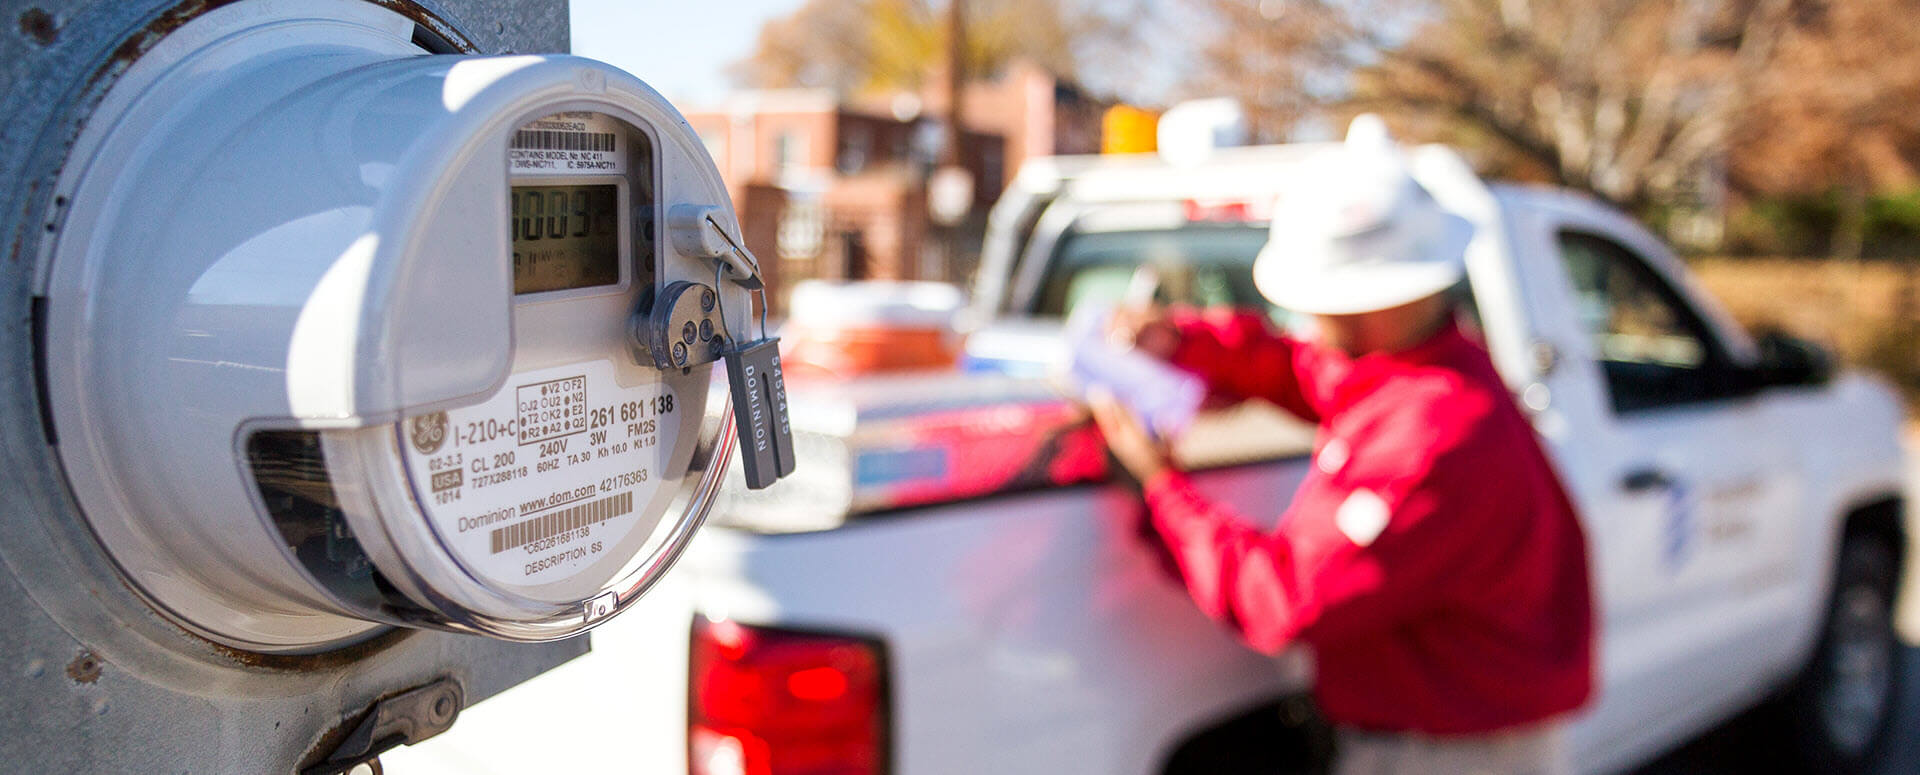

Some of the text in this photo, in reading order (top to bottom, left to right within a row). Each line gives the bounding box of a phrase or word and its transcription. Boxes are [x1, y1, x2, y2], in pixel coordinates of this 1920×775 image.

[546, 151, 568, 160] MODEL
[581, 152, 591, 161] NIC
[592, 152, 603, 160] 411
[548, 379, 582, 394] V2 F2
[528, 392, 583, 411] J2 U2 N2
[528, 405, 583, 424] T2 K2 E2
[590, 394, 674, 429] 261 681 138
[745, 365, 767, 452] DOMINION
[528, 417, 584, 438] R2 A2 Q2
[471, 419, 656, 473] CL 200 240V 3W FM2S
[537, 459, 560, 473] 60HZ
[567, 454, 579, 466] TA
[581, 451, 591, 463] 30
[598, 447, 609, 458] Kh
[612, 442, 627, 454] 10.0
[634, 439, 643, 449] Kt
[645, 436, 656, 447] 1.0
[432, 469, 463, 493] USA
[458, 469, 648, 533] Dominion www.dom.com 42176363
[525, 541, 603, 576] DESCRIPTION SS
